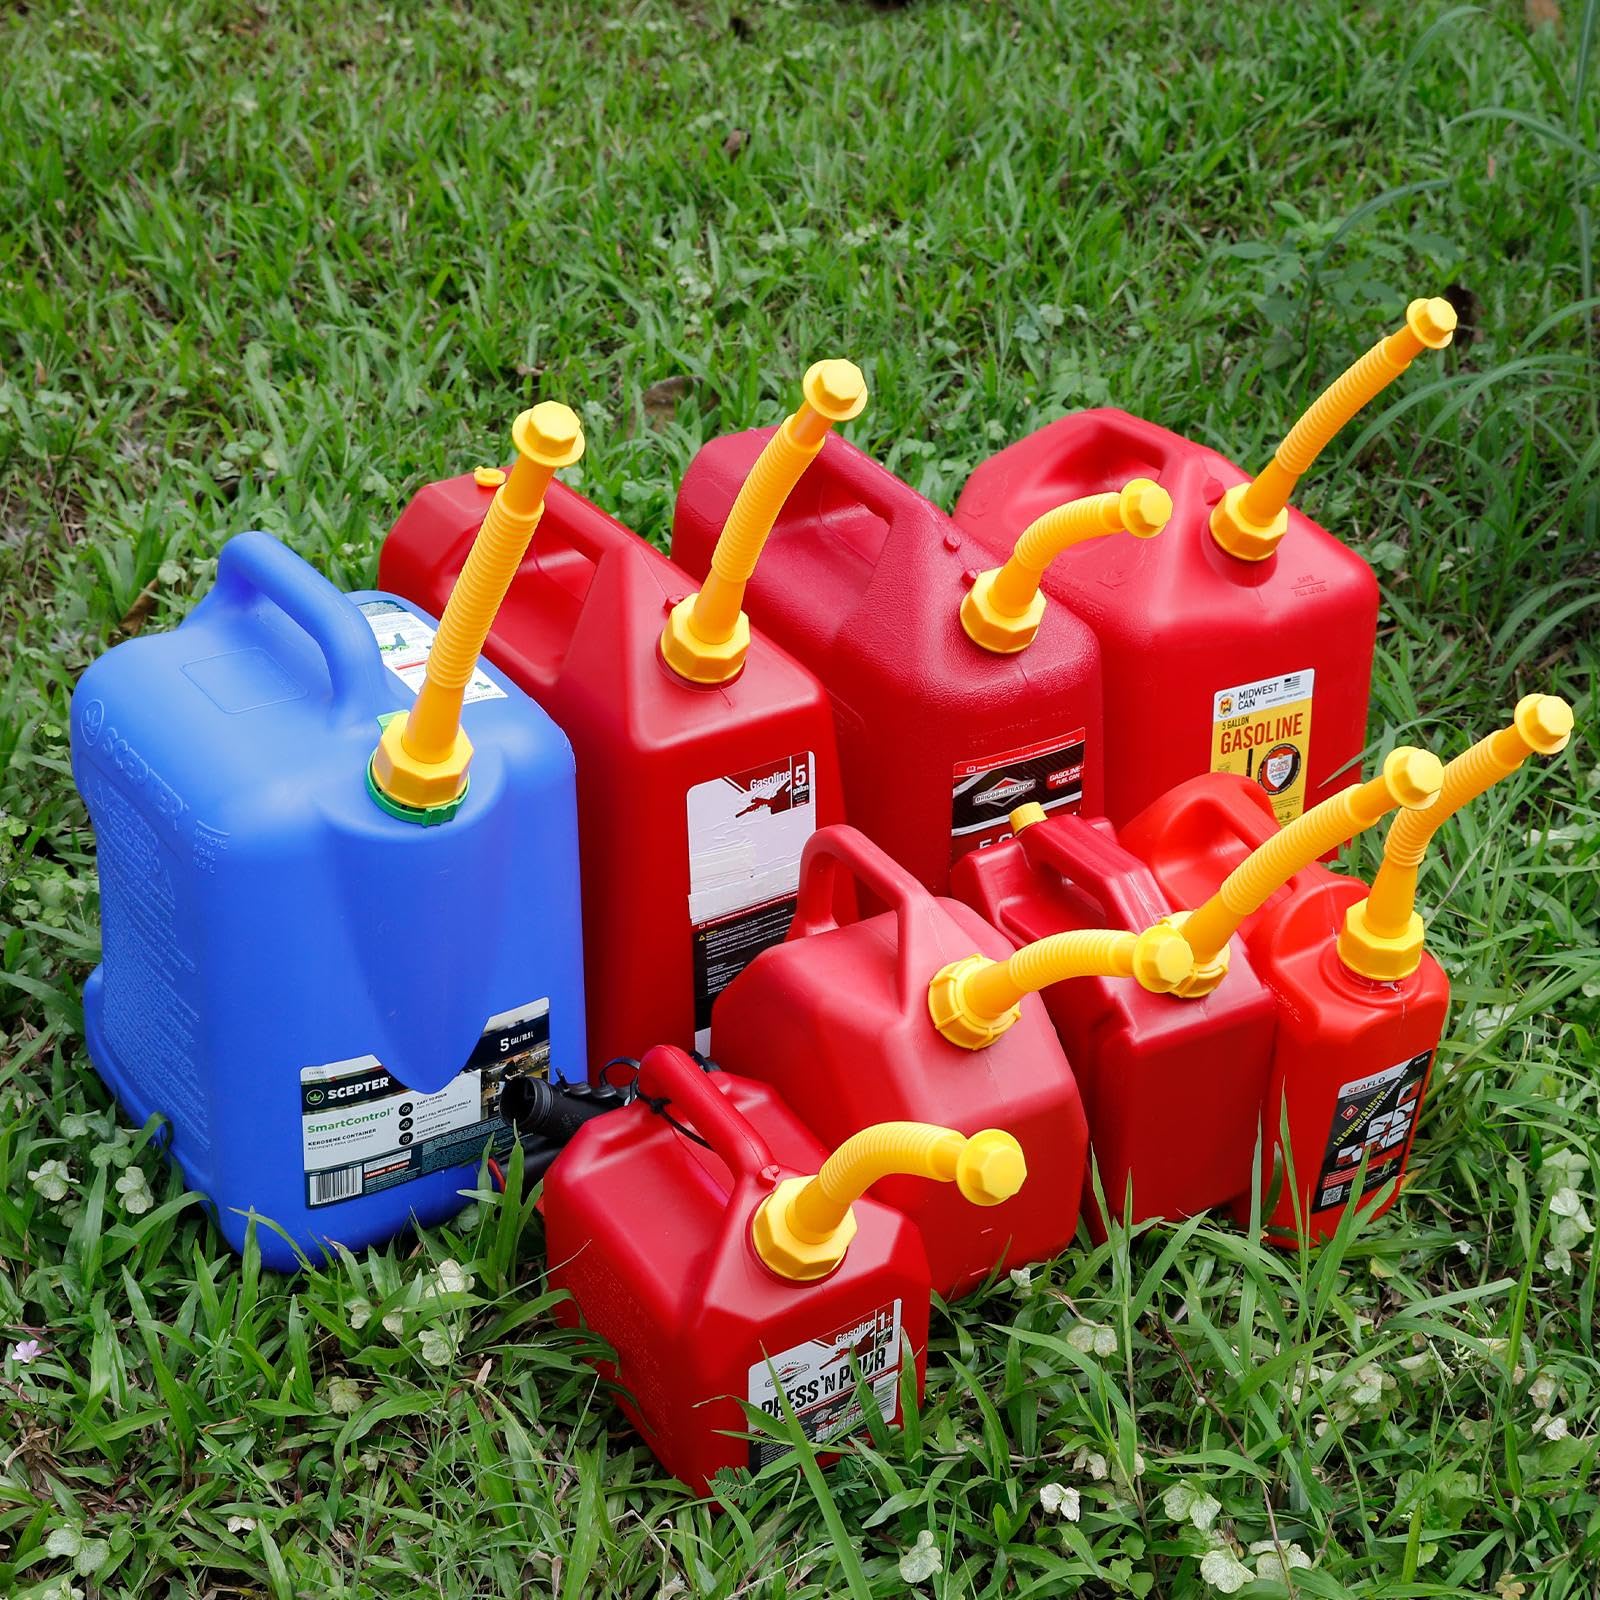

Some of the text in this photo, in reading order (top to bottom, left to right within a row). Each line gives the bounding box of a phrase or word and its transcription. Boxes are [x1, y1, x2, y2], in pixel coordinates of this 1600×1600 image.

[1238, 682, 1279, 701] MIDWEST
[1237, 699, 1256, 711] CAN
[1227, 716, 1249, 729] GALLON
[1220, 712, 1304, 755] GASOLINE
[750, 770, 791, 791] Gasoline
[795, 763, 806, 786] 5
[1049, 766, 1081, 782] GASOLINE
[1055, 773, 1080, 786] FUEL CAN
[792, 784, 809, 796] gallon
[500, 1037, 510, 1053] 5
[327, 1076, 389, 1100] SCEPTER
[1346, 1076, 1386, 1095] SEAFLO
[307, 1108, 391, 1134] SmartControl
[308, 1128, 377, 1146] KEROSENE CONTAINER
[835, 1319, 876, 1344] Gasoline
